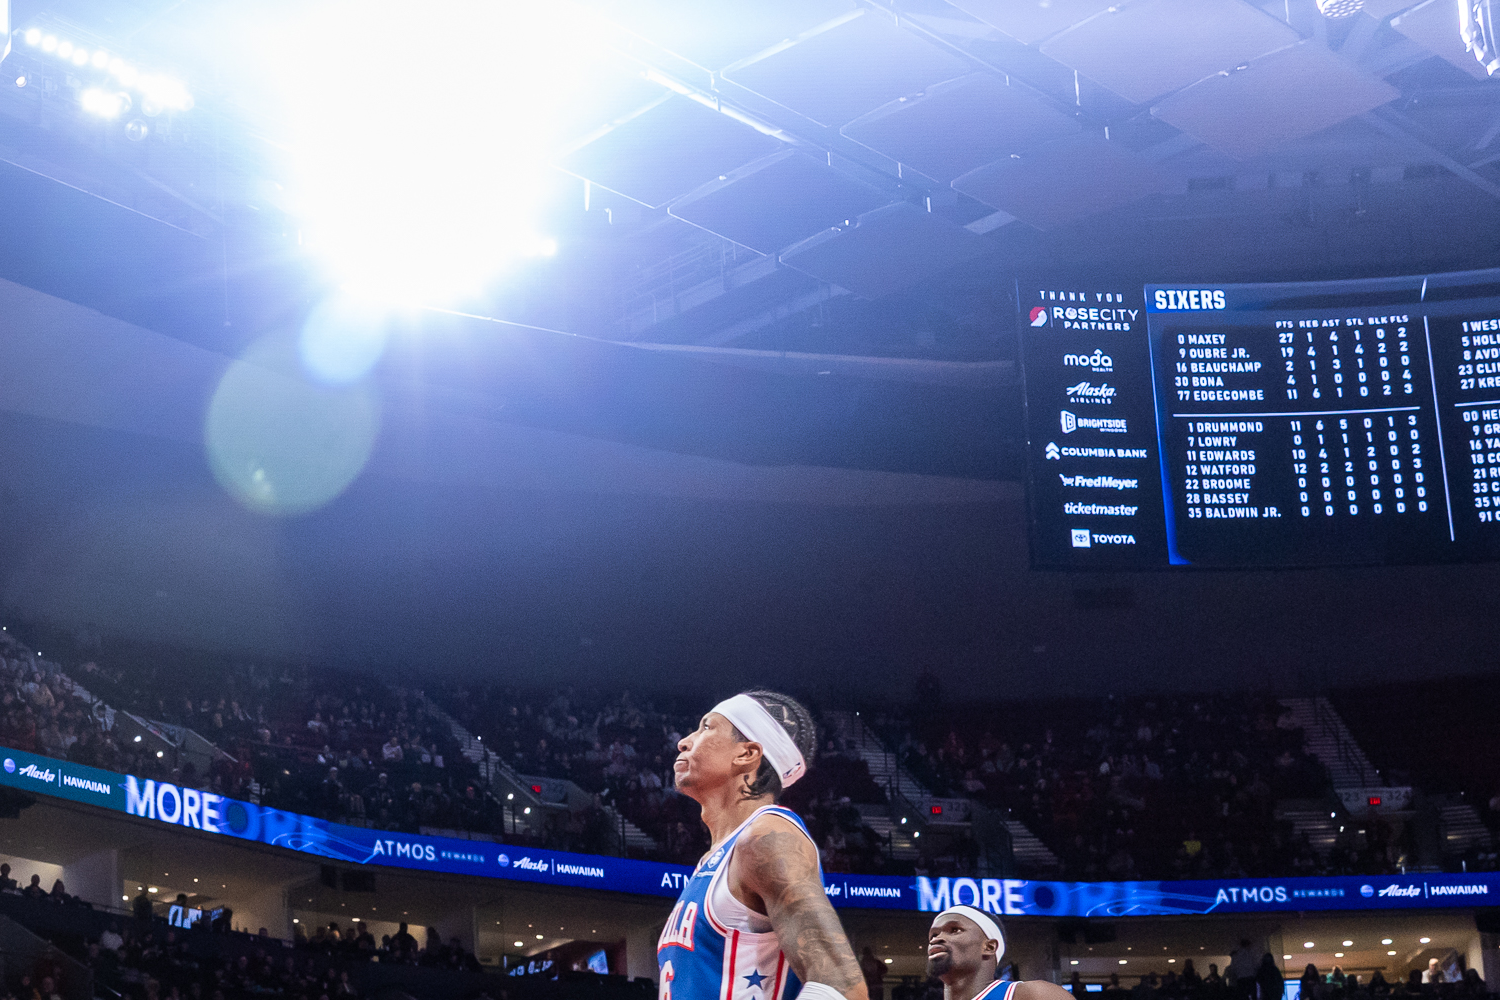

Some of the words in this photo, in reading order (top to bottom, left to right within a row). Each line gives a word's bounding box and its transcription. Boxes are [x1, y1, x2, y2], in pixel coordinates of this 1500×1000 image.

[1039, 290, 1086, 302] THANK
[1096, 292, 1123, 303] YOU
[1154, 289, 1226, 310] SIXERS
[1063, 320, 1131, 332] PARTNERS
[1275, 320, 1294, 329] PTS
[1299, 319, 1319, 328] REB
[1321, 318, 1340, 328] AST
[1346, 317, 1364, 327] STL
[1367, 316, 1388, 326] BLK
[1390, 314, 1409, 324] FLS
[1177, 334, 1185, 345] 0
[1187, 334, 1226, 345] MAXEY
[1278, 332, 1294, 344] 27
[1306, 332, 1313, 343] 1
[1329, 331, 1338, 342] 4
[1354, 330, 1360, 341] 1
[1376, 328, 1385, 339] 0
[1397, 326, 1407, 338] 2
[1178, 348, 1186, 359] 9
[1189, 347, 1228, 359] OUBRE
[1231, 347, 1250, 359] JR.
[1280, 346, 1294, 358] 19
[1307, 346, 1316, 357] 4
[1331, 345, 1338, 356] 1
[1354, 344, 1364, 355] 4
[1377, 342, 1386, 353] 2
[1399, 341, 1408, 352] 2
[1063, 349, 1113, 367] moda
[1176, 362, 1188, 373] 16
[1190, 361, 1262, 373] BEAUCHAMP
[1285, 360, 1294, 372] 2
[1309, 359, 1316, 371] 1
[1332, 358, 1341, 370] 3
[1357, 358, 1363, 369] 1
[1379, 356, 1388, 367] 0
[1400, 355, 1410, 366] 0
[1174, 376, 1189, 387] 30
[1191, 376, 1224, 387] BONA
[1177, 390, 1190, 401] 77
[1193, 389, 1264, 401] EDGECOMBE
[1077, 418, 1127, 428] BRIGHTSIDE
[1188, 422, 1194, 433] 1
[1196, 421, 1263, 433] DRUMMOND
[1187, 436, 1195, 448] 7
[1197, 436, 1237, 447] LOWRY
[1061, 447, 1116, 458] COLUMBIA
[1117, 448, 1148, 459] BANK
[1186, 450, 1197, 461] 11
[1199, 450, 1256, 462] EDWARDS
[1185, 464, 1198, 476] 12
[1200, 464, 1256, 476] WATFORD
[1185, 478, 1199, 490] 22
[1202, 478, 1251, 490] BROOME
[1186, 493, 1201, 504] 28
[1203, 493, 1249, 504] BASSEY
[1064, 502, 1139, 516] ticketmaster
[1188, 507, 1202, 519] 35
[1205, 507, 1258, 519] BALDWIN
[1262, 506, 1282, 518] JR.
[1092, 534, 1136, 545] TOYOTA
[19, 763, 55, 783] Alaska
[63, 774, 110, 795] HAWAIIAN
[125, 774, 221, 834] MORE
[373, 839, 435, 862] ATMOS
[513, 856, 549, 873] Alaska
[557, 863, 604, 878] HAWAIIAN
[850, 886, 901, 898] HAWAIIAN
[917, 876, 1024, 915] MORE
[1216, 886, 1288, 903] ATMOS
[1378, 884, 1420, 897] Alaska
[1431, 884, 1488, 896] HAWAIIAN
